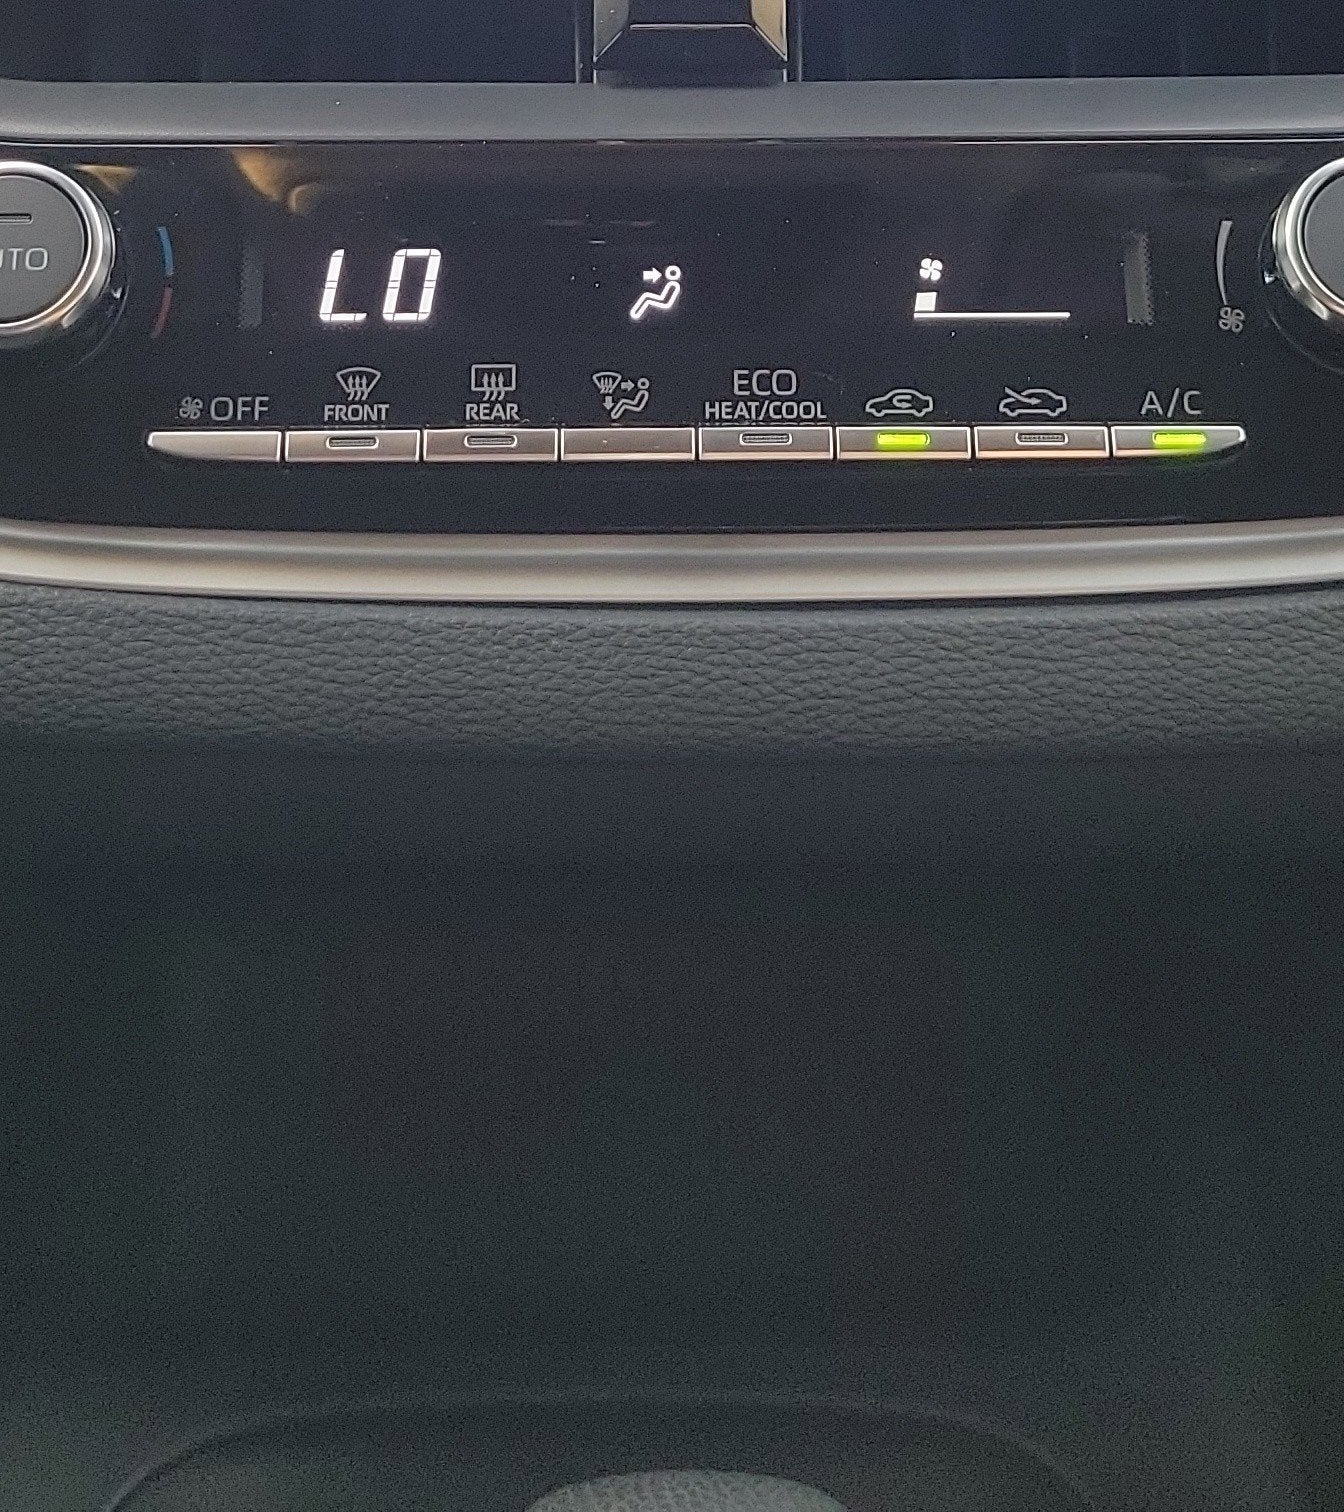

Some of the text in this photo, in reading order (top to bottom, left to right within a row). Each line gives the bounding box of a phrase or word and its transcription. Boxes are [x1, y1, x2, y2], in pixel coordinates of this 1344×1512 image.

[732, 369, 797, 397] ECO
[210, 396, 269, 422] OFF
[324, 403, 389, 421] FRONT
[464, 402, 519, 421] REAR
[704, 399, 827, 420] HEAT/COOL
[1141, 387, 1202, 416] A/C
